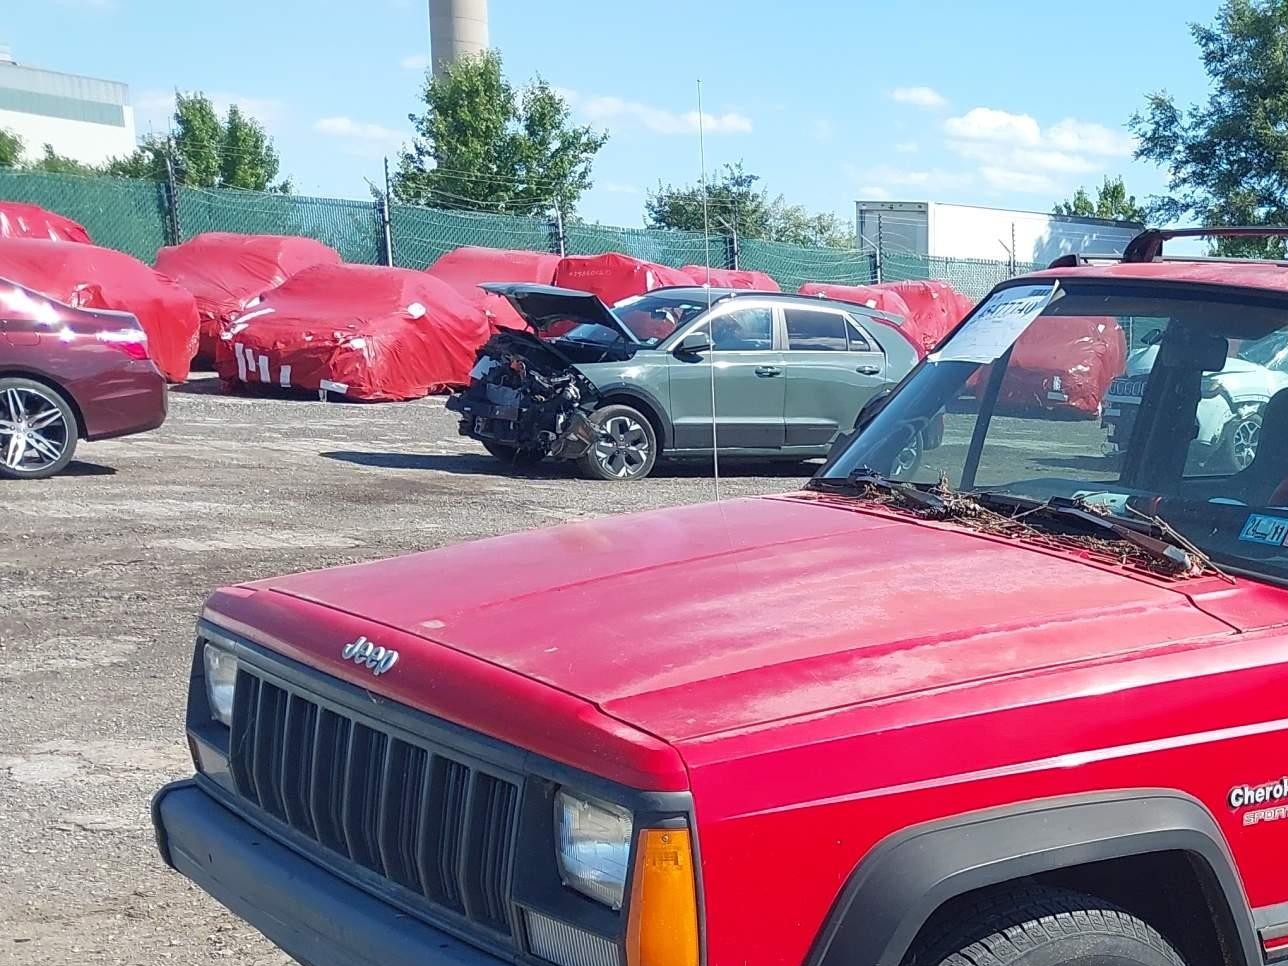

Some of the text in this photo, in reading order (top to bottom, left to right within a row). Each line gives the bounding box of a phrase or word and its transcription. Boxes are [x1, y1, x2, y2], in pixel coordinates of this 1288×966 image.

[1246, 518, 1285, 541] 24 11
[342, 636, 399, 676] Jeep
